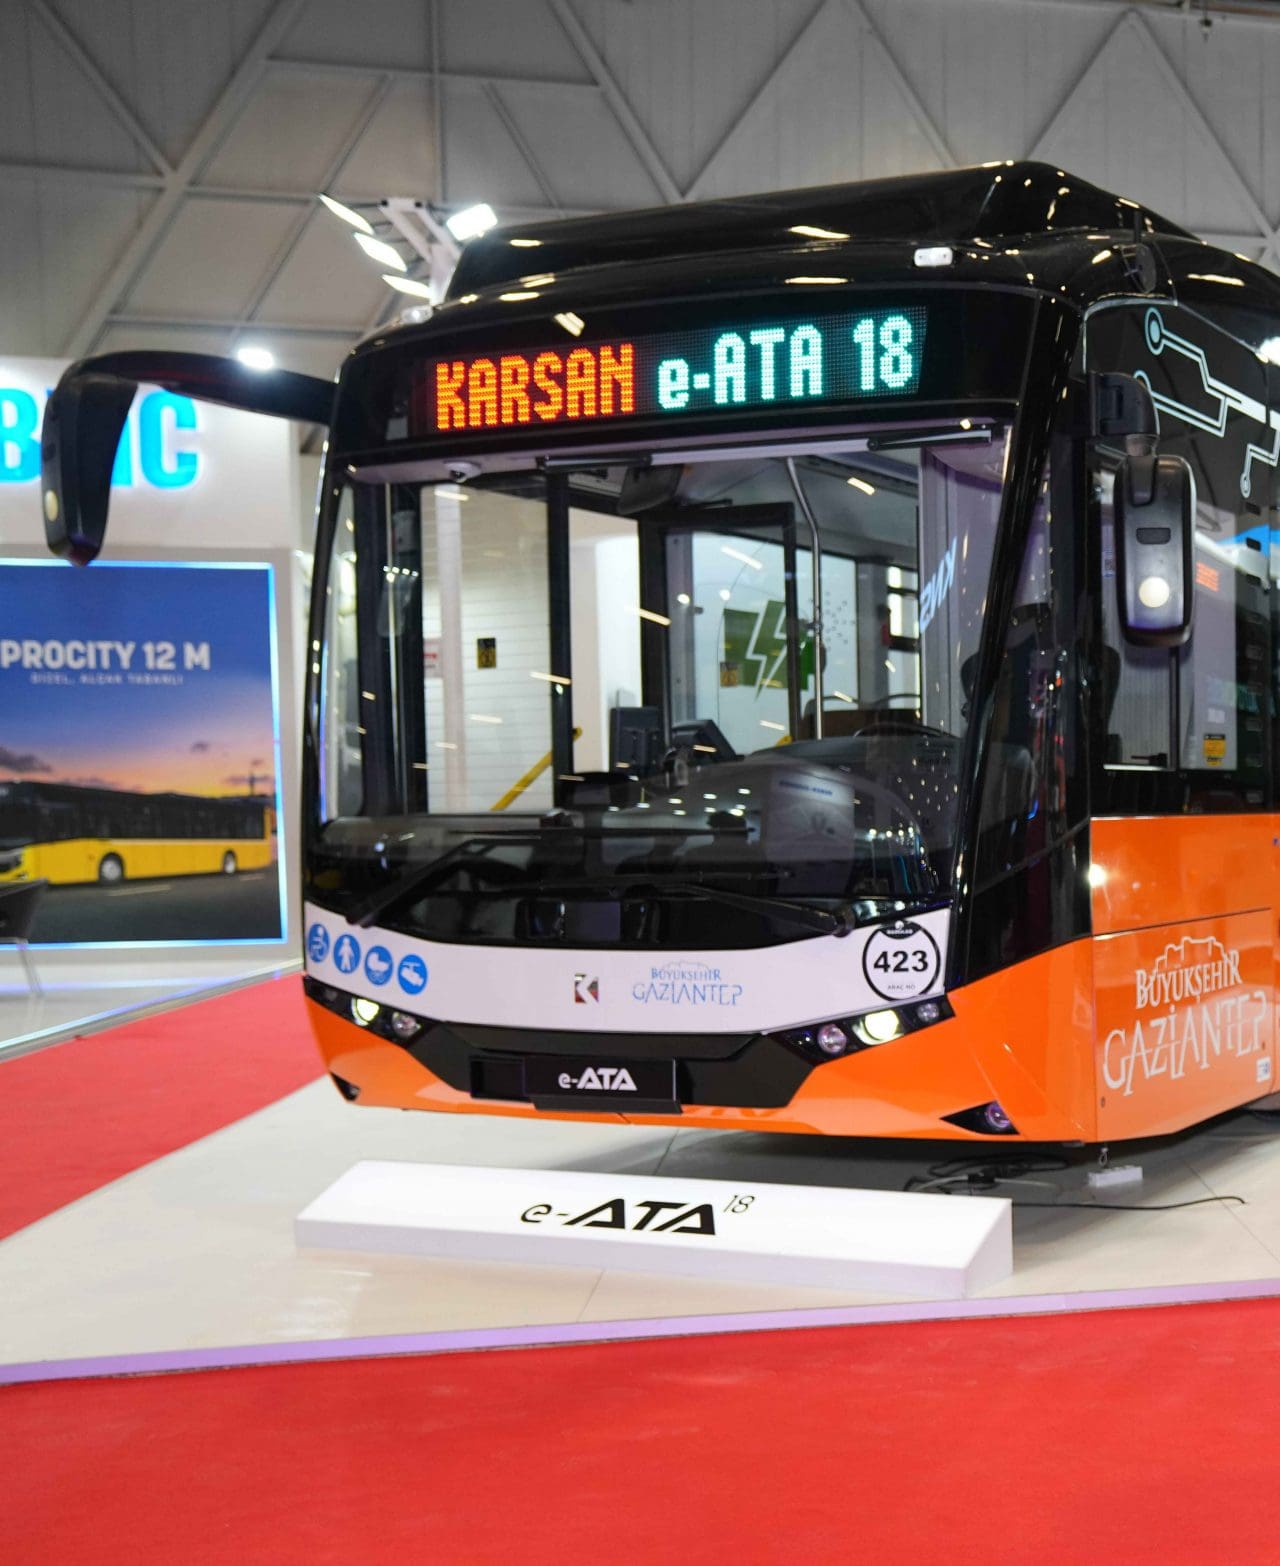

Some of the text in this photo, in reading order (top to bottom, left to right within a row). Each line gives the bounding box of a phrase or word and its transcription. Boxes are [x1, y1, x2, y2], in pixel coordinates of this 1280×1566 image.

[436, 315, 913, 430] KARSAN e-ATA 18
[0, 388, 197, 490] BC
[0, 640, 210, 670] PROCITY 12 M
[873, 950, 929, 973] 423
[1103, 990, 1267, 1096] GAZİANTEP
[558, 1066, 638, 1092] e-ATA
[520, 1194, 756, 1236] e-ATA 18
